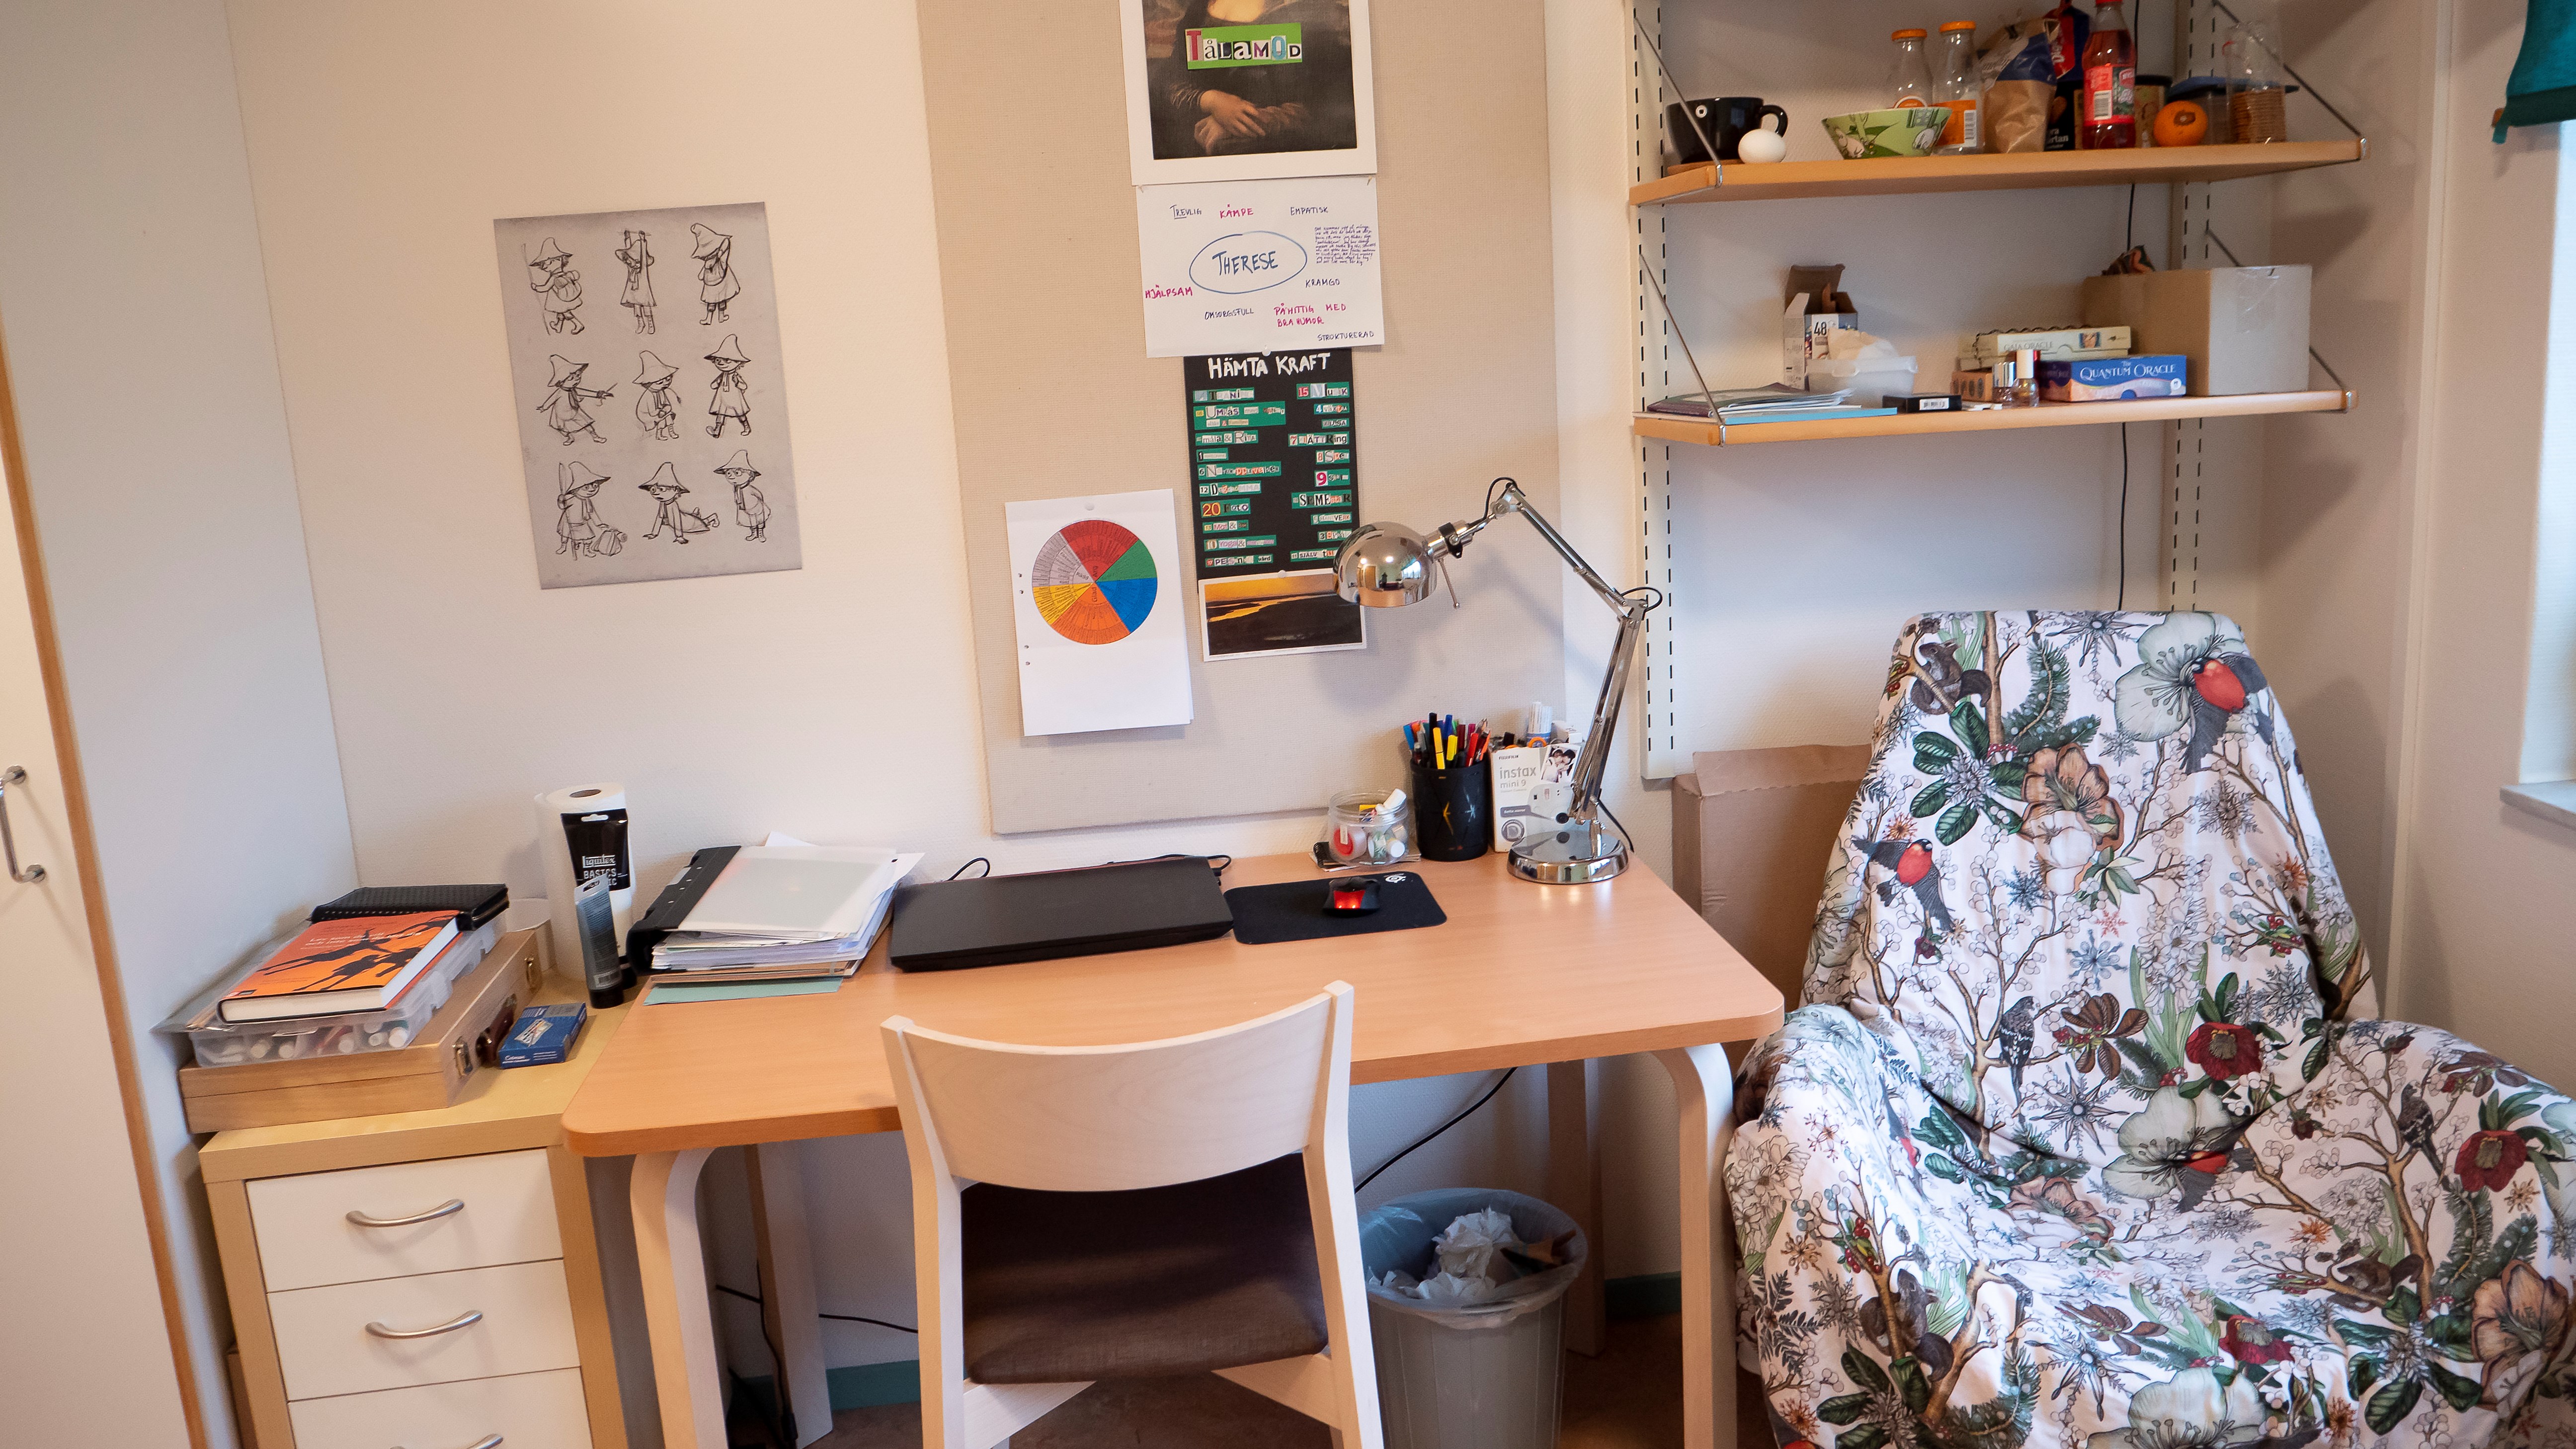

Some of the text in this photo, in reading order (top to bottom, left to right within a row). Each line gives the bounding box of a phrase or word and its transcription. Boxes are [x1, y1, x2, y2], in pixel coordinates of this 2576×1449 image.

[1220, 204, 1254, 219] KÄMPE
[1290, 207, 1328, 216] EMPATISK
[1212, 250, 1279, 276] THERESE
[1145, 284, 1193, 299] HJÄLPSAM
[1205, 308, 1254, 320] OMSORGSFULL
[1274, 302, 1314, 316] PÅHITTIG
[1277, 316, 1324, 327] BRA HUMOR
[1814, 322, 1827, 336] 48
[1208, 352, 1331, 379] HÄMTA KRAFT
[2080, 366, 2131, 381] QUANTUM
[2134, 363, 2176, 378] ORACLE
[1316, 404, 1322, 413] 4
[1290, 435, 1297, 445] 7
[1316, 472, 1327, 485] 9
[1202, 502, 1221, 517] 20
[1500, 767, 1536, 780] instax
